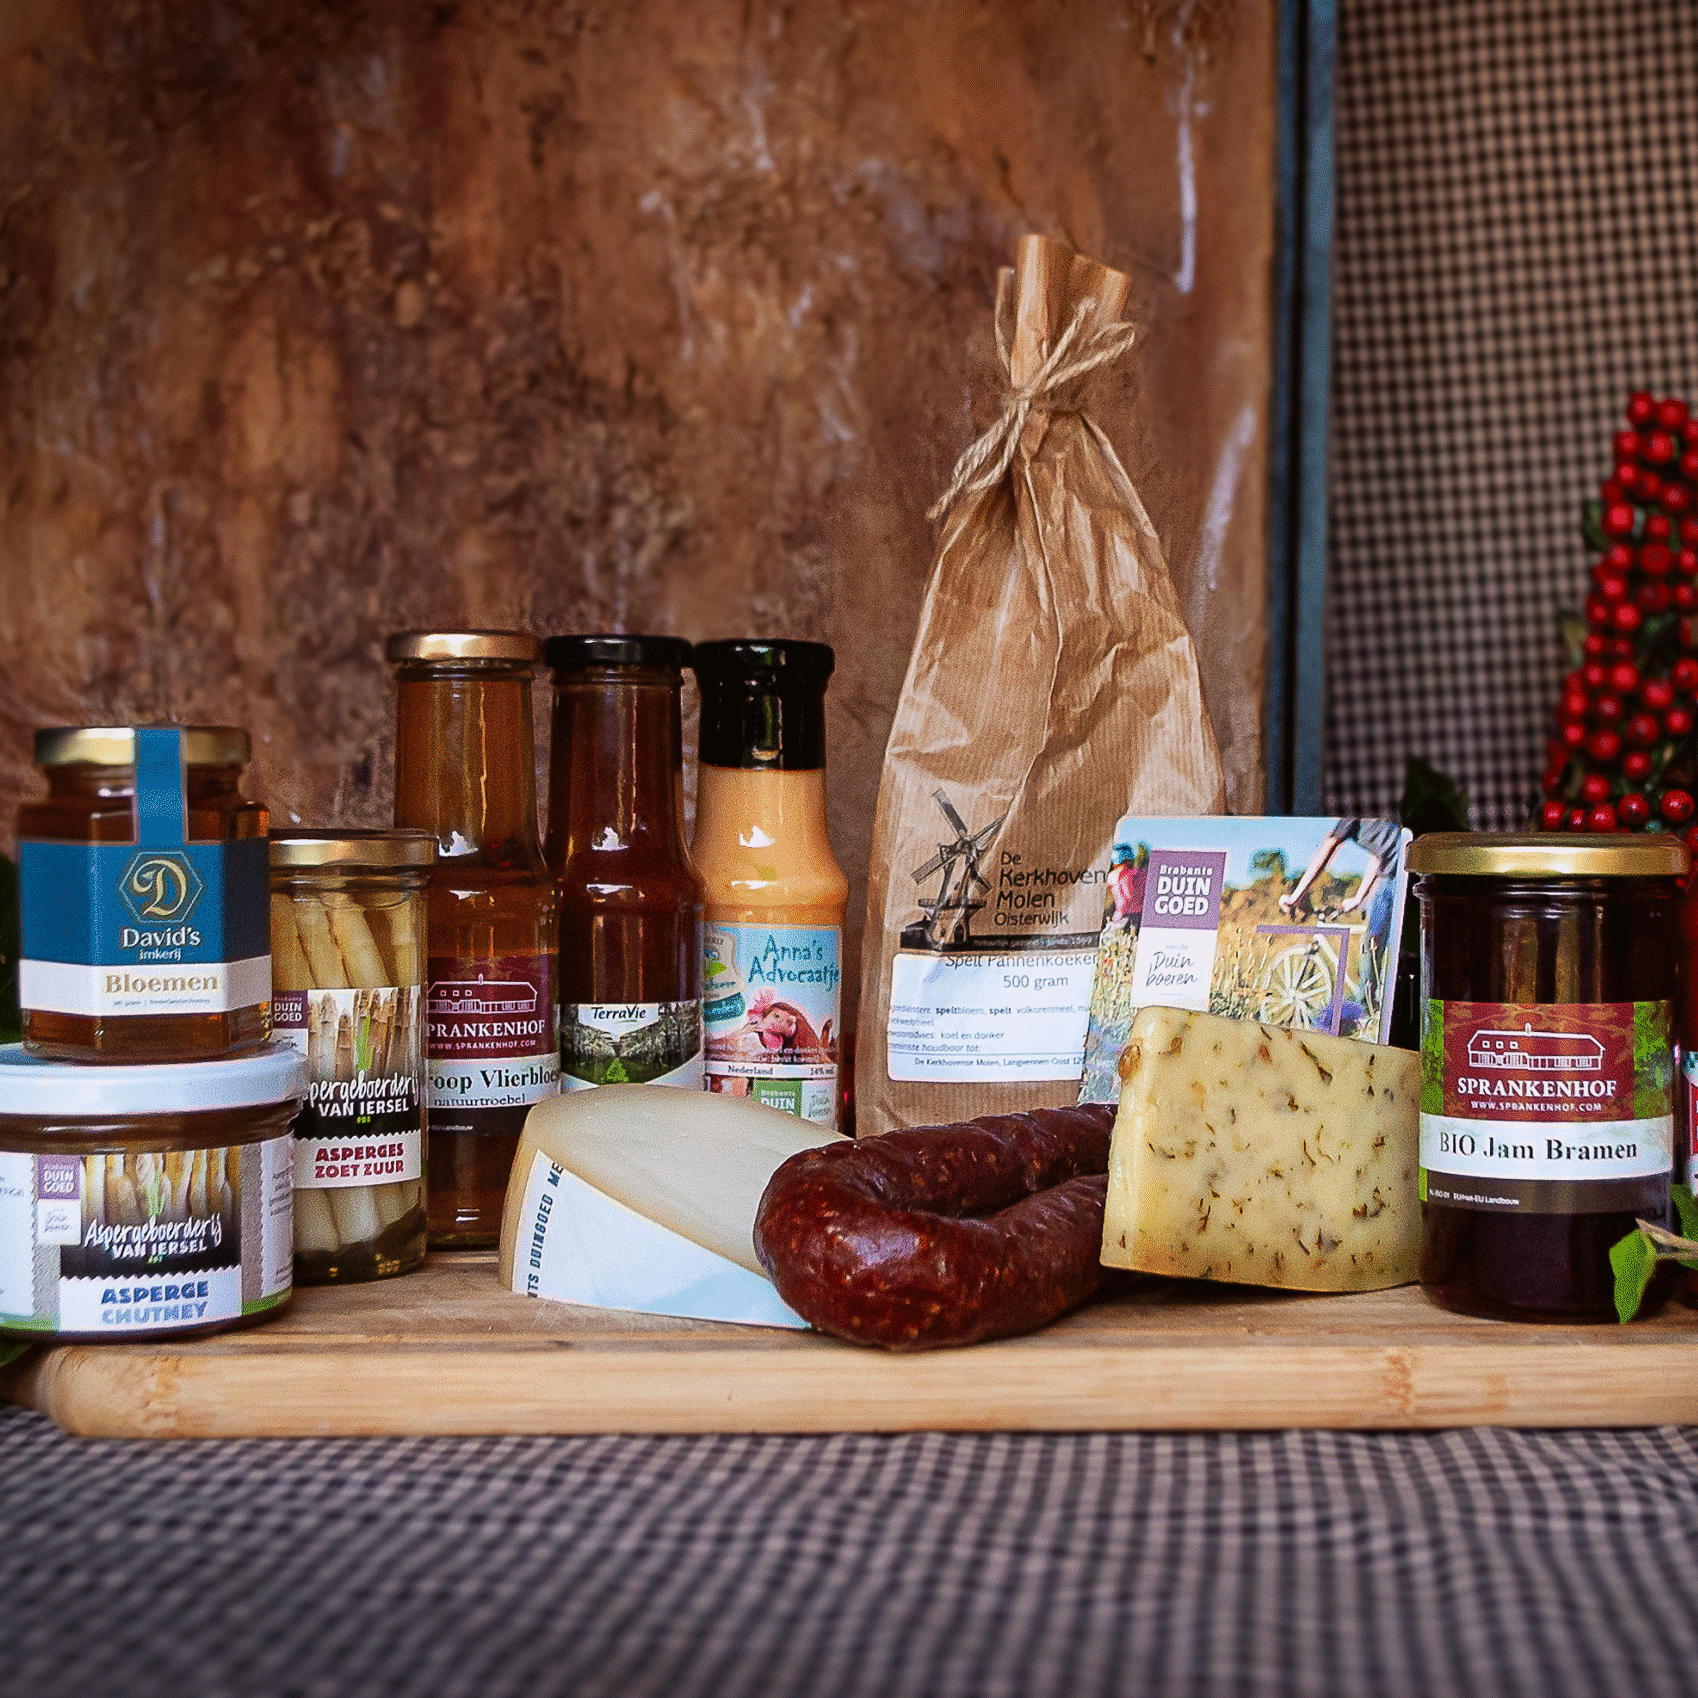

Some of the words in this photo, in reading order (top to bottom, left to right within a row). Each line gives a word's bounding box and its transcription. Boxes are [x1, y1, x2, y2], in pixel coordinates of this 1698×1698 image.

[1001, 851, 1022, 865] De
[1001, 868, 1109, 888] Kerkhoven
[1157, 875, 1211, 896] DUIN
[997, 889, 1055, 909] Molen
[1154, 895, 1209, 916] GOED
[994, 910, 1068, 929] Oisterwijk
[123, 926, 201, 949] David's
[139, 948, 182, 962] imkerij
[763, 934, 823, 962] Anna's
[1153, 951, 1195, 972] Duin
[105, 973, 218, 993] Bloemen
[748, 956, 840, 992] Advocaatje
[1003, 974, 1029, 989] 500
[1034, 976, 1069, 991] gram
[1146, 963, 1198, 988] boeren
[273, 1012, 303, 1022] GOED
[274, 1002, 303, 1012] DUIN
[591, 1004, 647, 1020] TerraVie
[989, 1006, 1012, 1016] spelt
[427, 1020, 546, 1038] PRANKENHOF
[940, 1031, 958, 1040] koel
[727, 1065, 773, 1076] Nederland
[303, 1069, 419, 1109] pergeboerderij
[1457, 1076, 1617, 1098] SPRANKENHOF
[318, 1102, 354, 1117] VAN
[359, 1098, 409, 1115] IERSEL
[433, 1093, 526, 1107] natuurtroebel
[760, 1097, 795, 1110] DUIN
[1470, 1100, 1602, 1112] WWW.SPRANKENHOF.COM
[315, 1142, 404, 1162] ASPERGES
[1439, 1132, 1475, 1156] BIO
[1483, 1136, 1534, 1160] Jam
[1545, 1138, 1637, 1160] Bramen
[315, 1164, 360, 1179] ZOET
[363, 1160, 404, 1176] ZUUR
[83, 1213, 222, 1252] Aspergeboerderij
[530, 1193, 554, 1269] DUINGOED
[112, 1242, 146, 1260] VAN
[151, 1240, 208, 1257] IERSEL
[101, 1281, 209, 1305] ASPERGE
[102, 1301, 209, 1325] CHUTNEY
